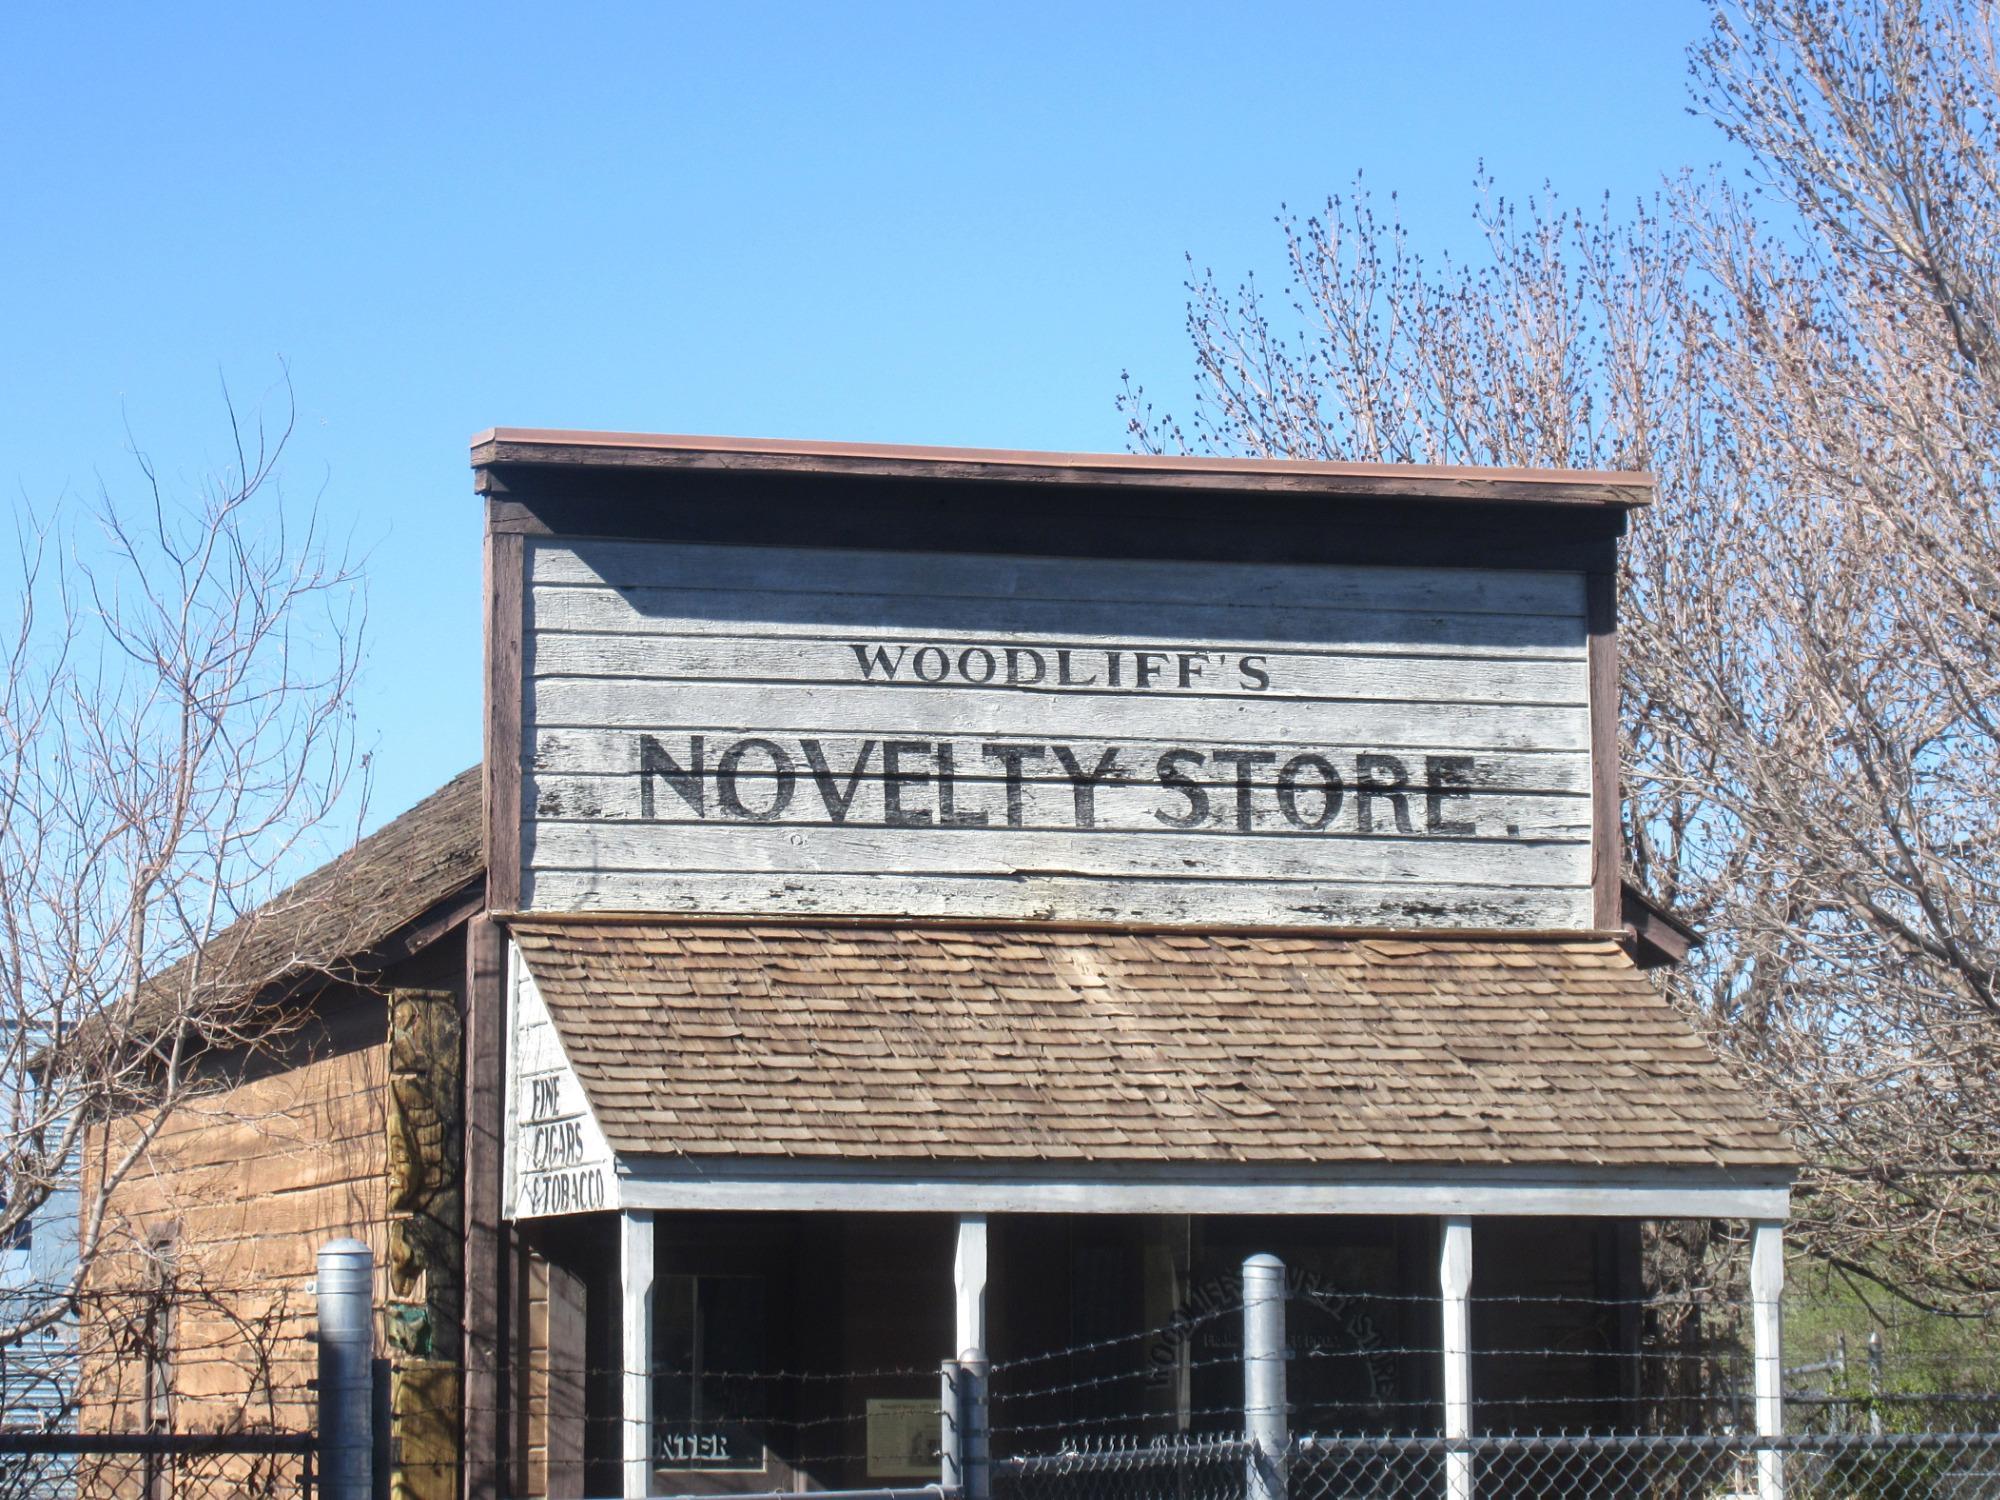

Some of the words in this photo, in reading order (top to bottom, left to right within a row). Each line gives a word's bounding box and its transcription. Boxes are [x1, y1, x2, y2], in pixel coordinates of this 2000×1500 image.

[848, 644, 1270, 691] WOODLIFF'S
[639, 733, 1120, 828] NOVELTY
[531, 1076, 560, 1119] FINE
[532, 1121, 584, 1168] CIGARS
[542, 1168, 605, 1214] TOBACCO
